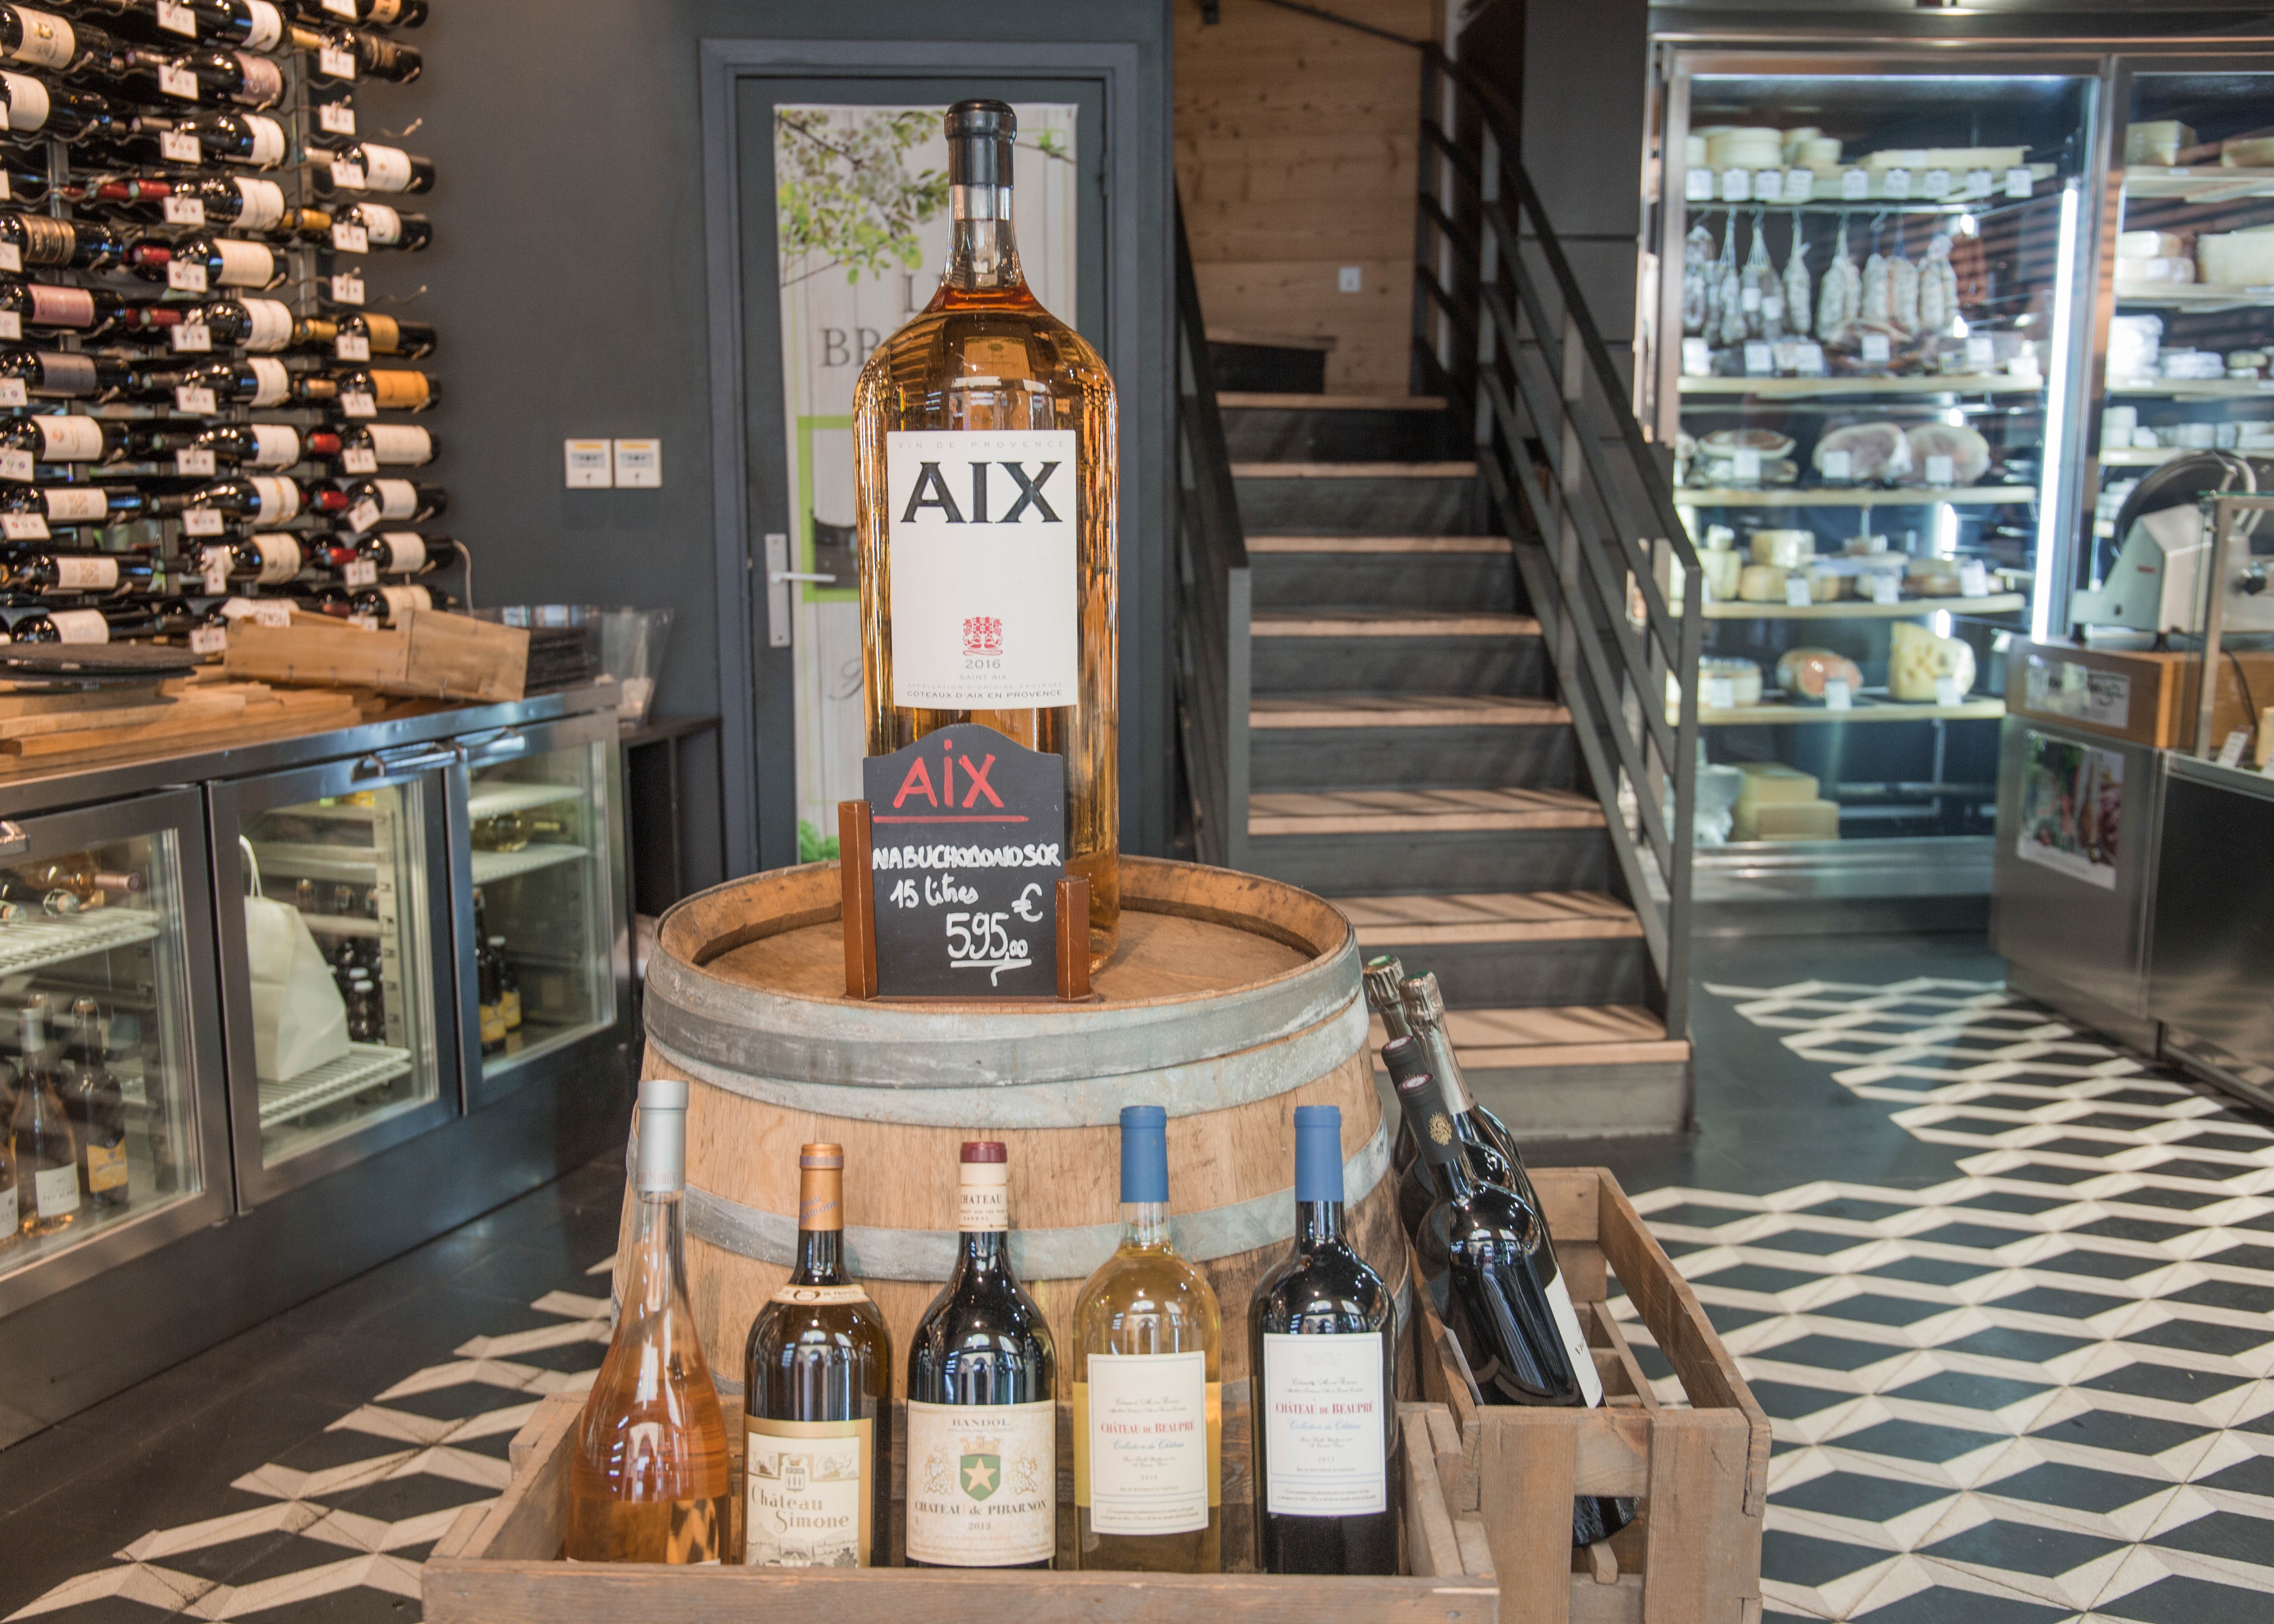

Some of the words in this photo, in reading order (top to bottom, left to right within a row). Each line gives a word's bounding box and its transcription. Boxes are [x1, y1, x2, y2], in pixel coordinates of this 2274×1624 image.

[900, 461, 1063, 524] AIX
[964, 659, 1001, 669] 2016
[1007, 689, 1063, 699] PROVENCE
[890, 879, 919, 909] 15
[1011, 882, 1044, 922] €
[1332, 1399, 1374, 1414] BEAUPRÉ
[952, 1418, 1010, 1427] BANDOL
[1155, 1418, 1195, 1433] BEAUPRÉ
[751, 1484, 823, 1511] Château
[915, 1500, 962, 1514] CHATEAU
[970, 1506, 982, 1515] de
[774, 1510, 850, 1533] Simone
